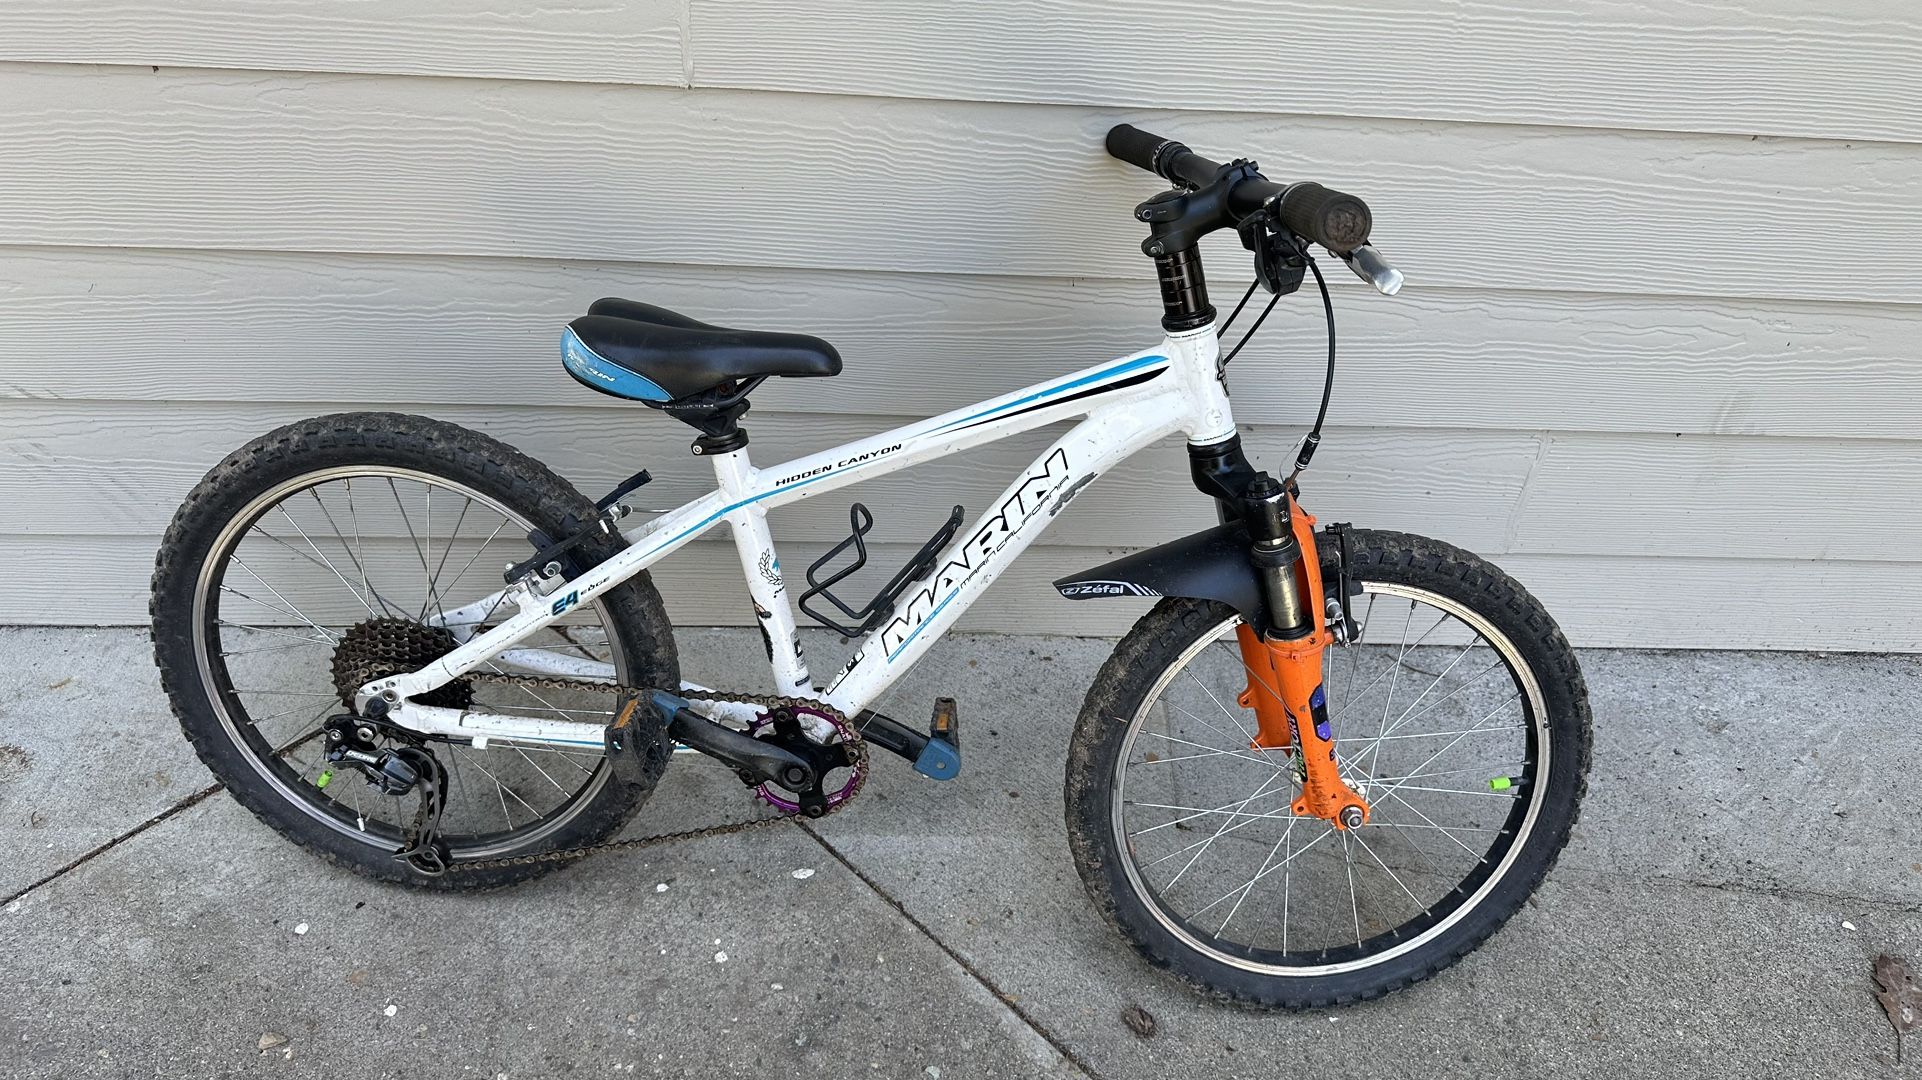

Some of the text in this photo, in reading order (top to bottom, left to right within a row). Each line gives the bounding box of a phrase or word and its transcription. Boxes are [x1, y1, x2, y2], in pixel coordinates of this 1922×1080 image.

[775, 443, 902, 487] HIDDEN CANYON
[881, 447, 1069, 657] MARIN
[551, 590, 579, 616] E4
[1080, 584, 1124, 594] Zéfal
